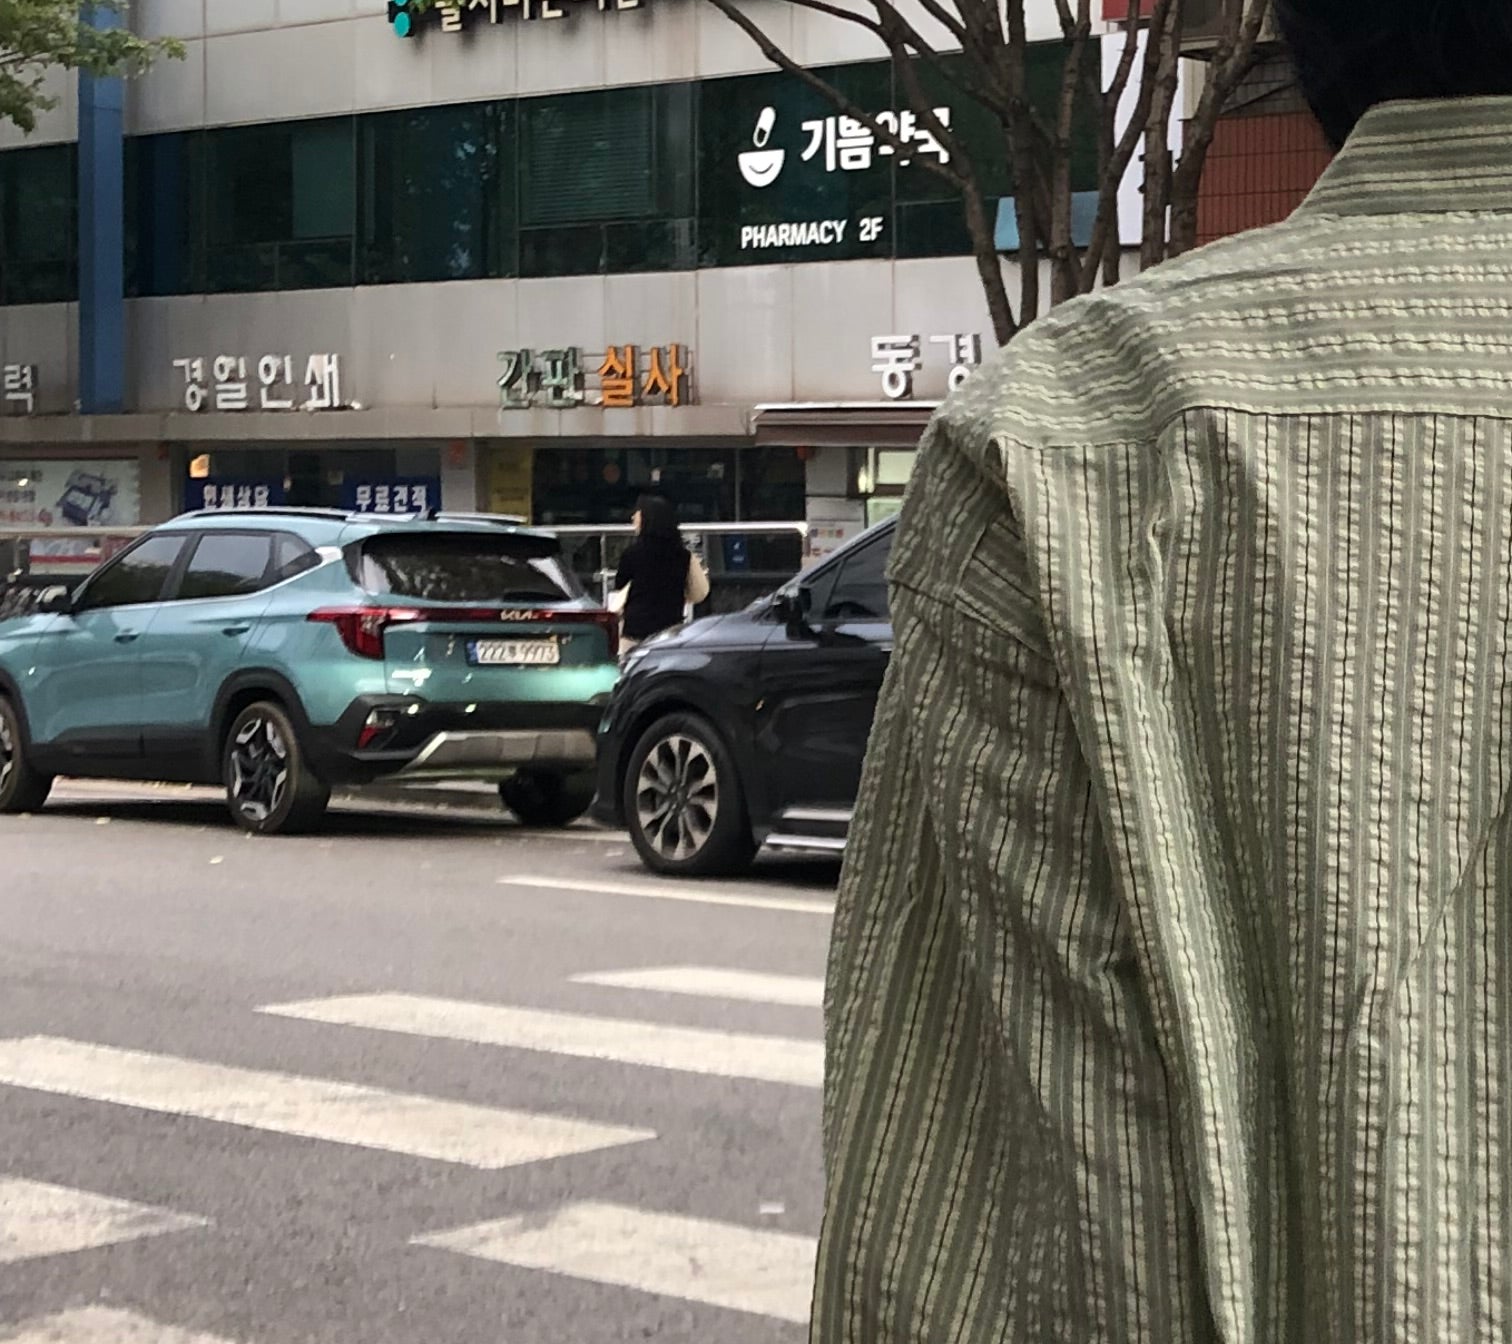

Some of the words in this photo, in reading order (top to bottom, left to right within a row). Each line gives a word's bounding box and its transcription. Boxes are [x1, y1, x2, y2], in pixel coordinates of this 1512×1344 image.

[741, 218, 847, 249] PHARMACY
[859, 216, 884, 242] 2F
[4, 364, 35, 413] 력
[173, 354, 338, 411] 경일인쇄
[600, 343, 684, 407] 실사
